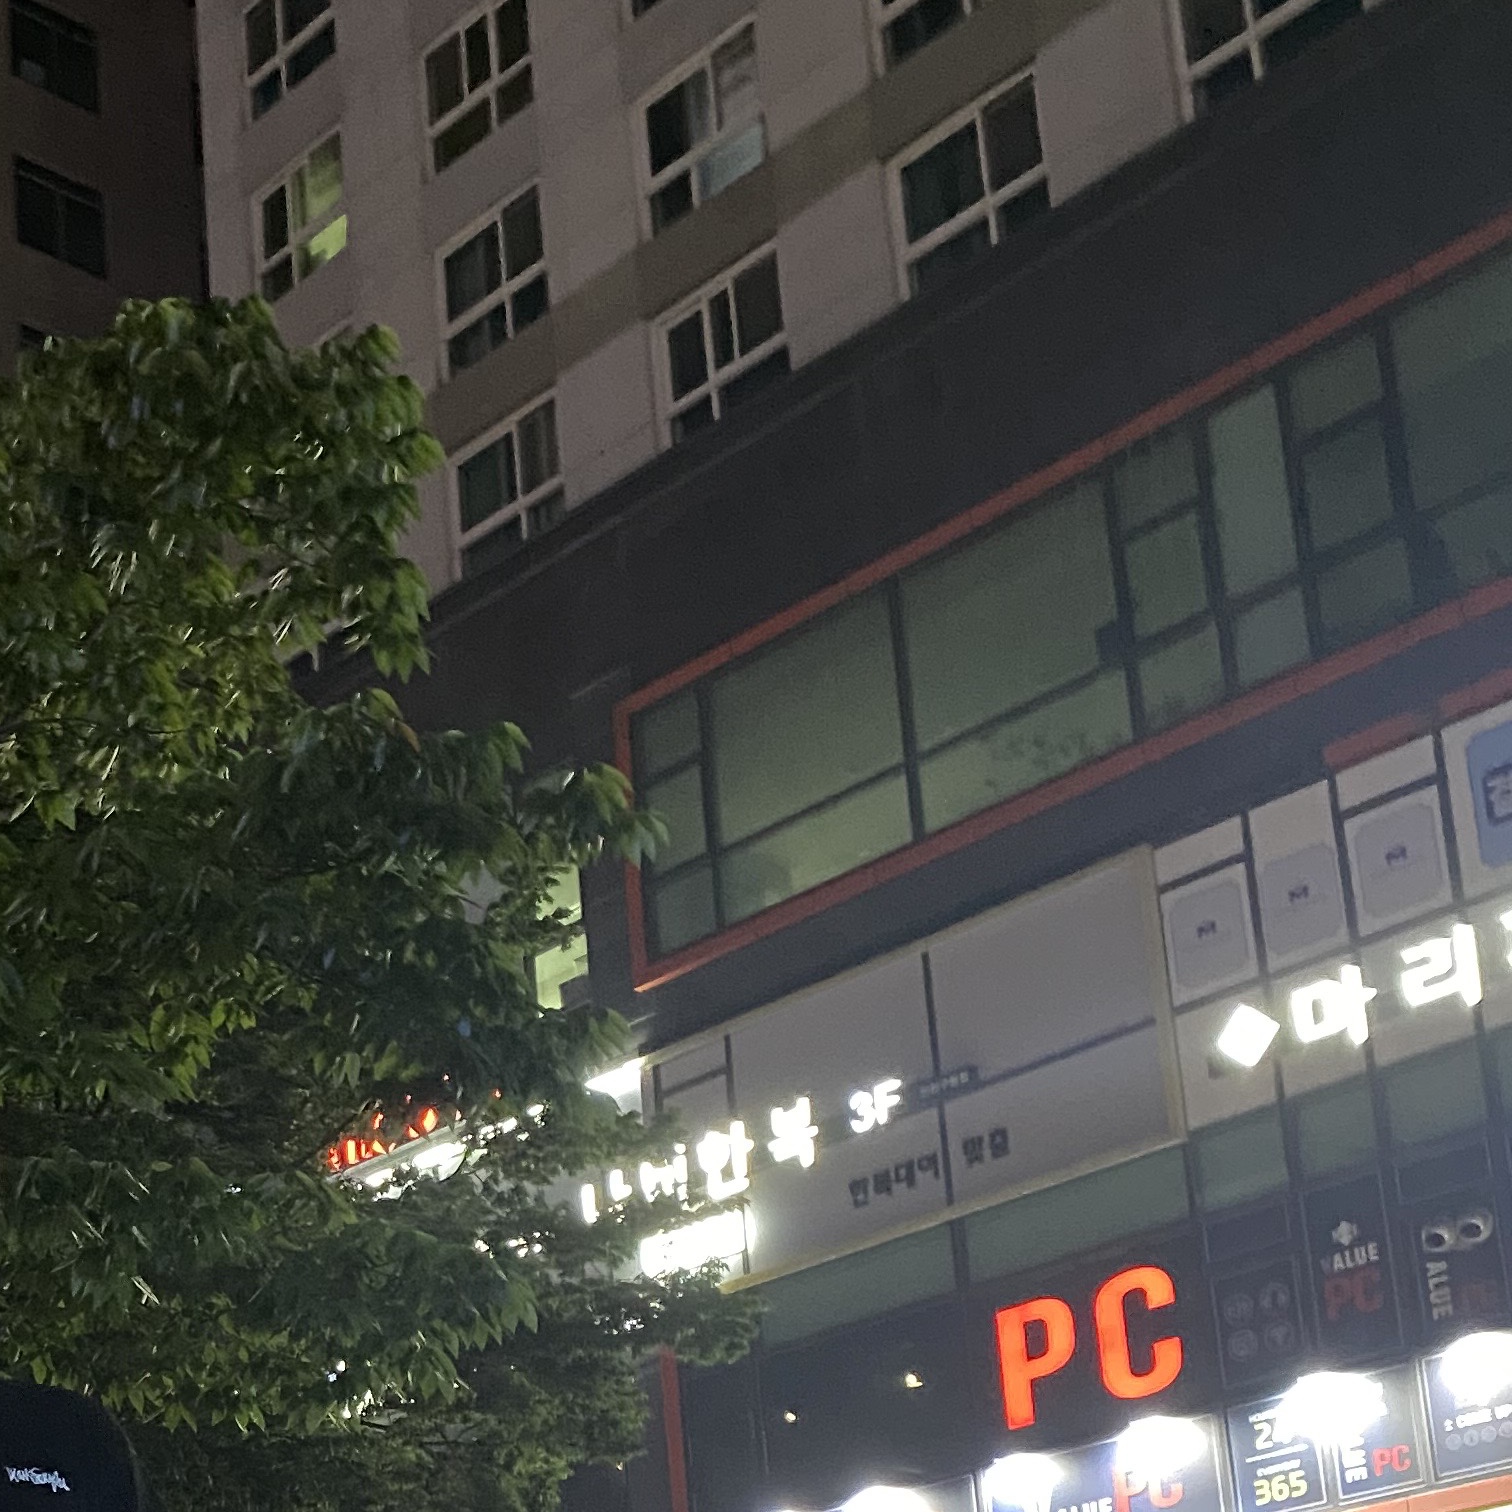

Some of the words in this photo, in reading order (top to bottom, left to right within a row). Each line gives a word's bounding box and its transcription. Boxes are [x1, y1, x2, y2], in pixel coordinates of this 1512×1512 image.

[849, 1078, 903, 1134] 3F
[995, 1264, 1183, 1430] PC
[1372, 1444, 1413, 1478] PC
[1253, 1469, 1309, 1507] 365
